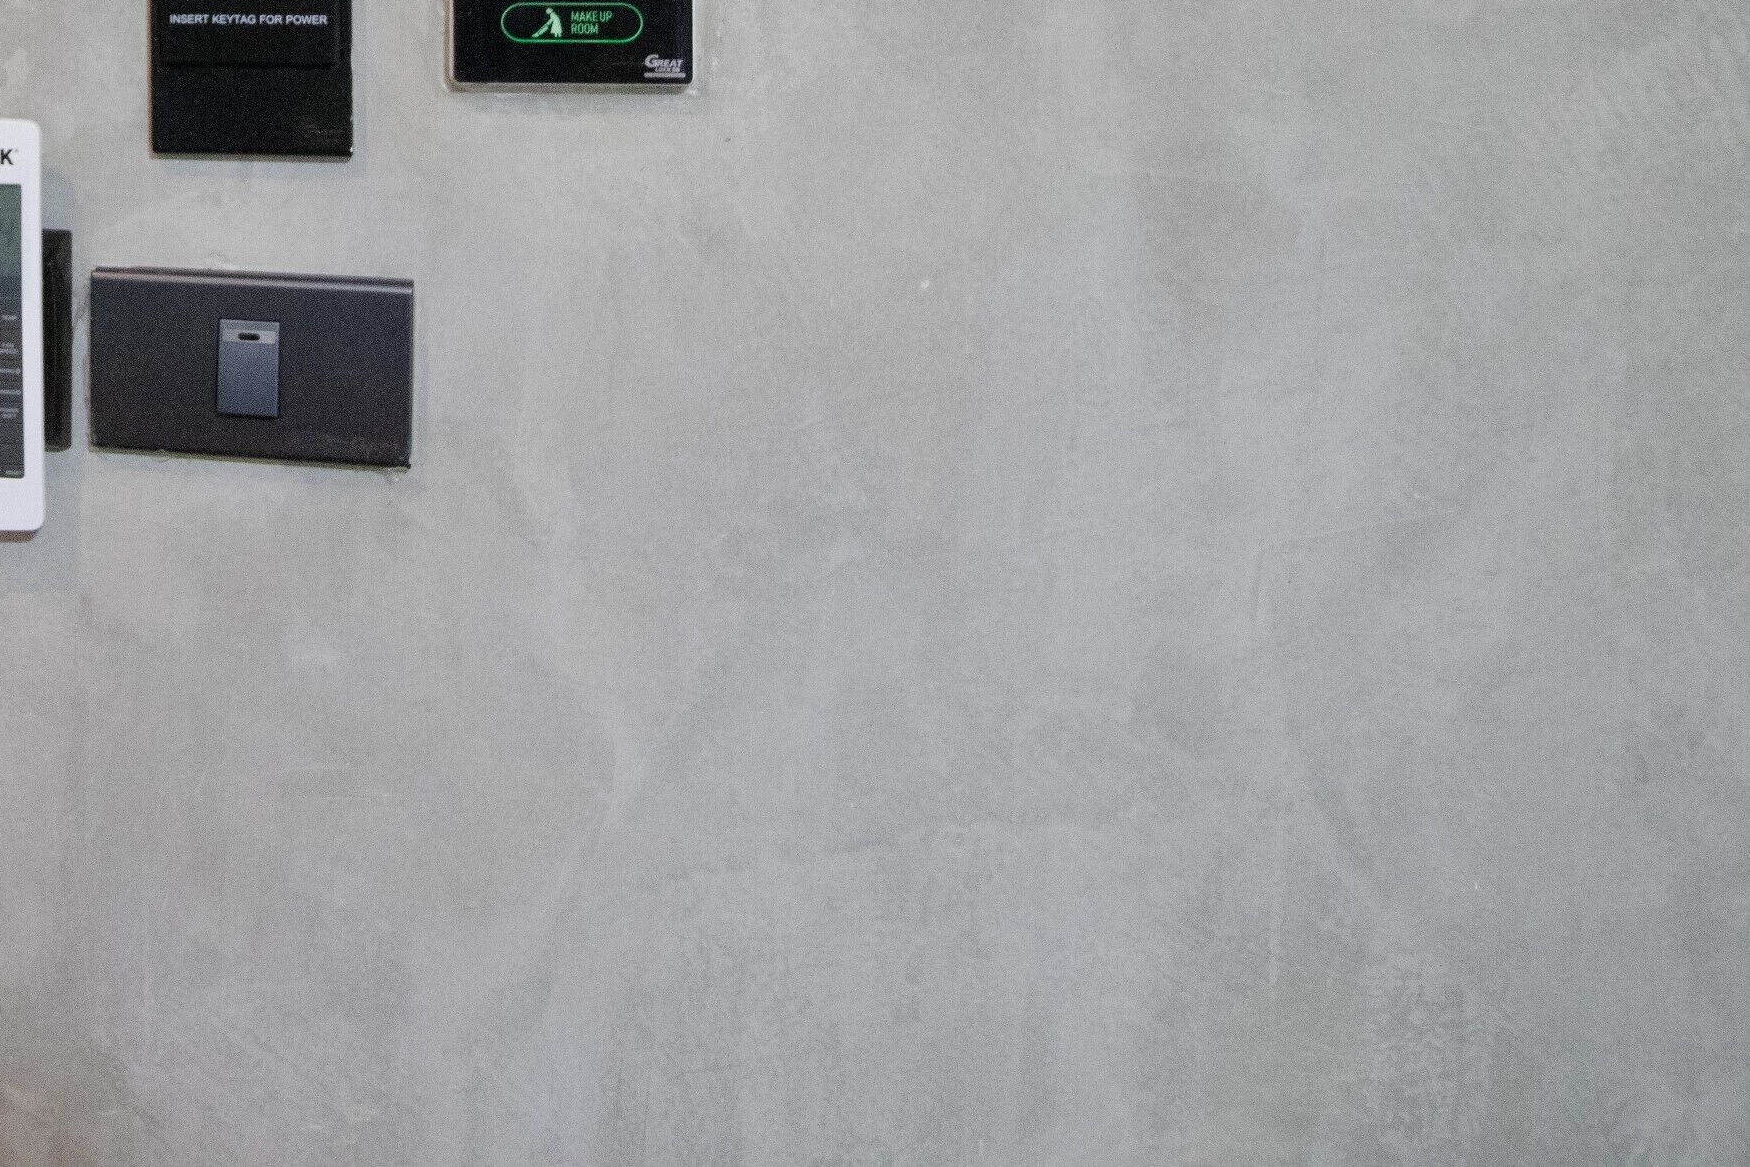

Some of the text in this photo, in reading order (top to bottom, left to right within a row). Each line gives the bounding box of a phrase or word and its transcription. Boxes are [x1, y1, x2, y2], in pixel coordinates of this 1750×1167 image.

[169, 14, 328, 25] INSERT KEYTAG FOR POWER
[571, 11, 613, 22] MAKE UP
[571, 23, 599, 34] ROOM
